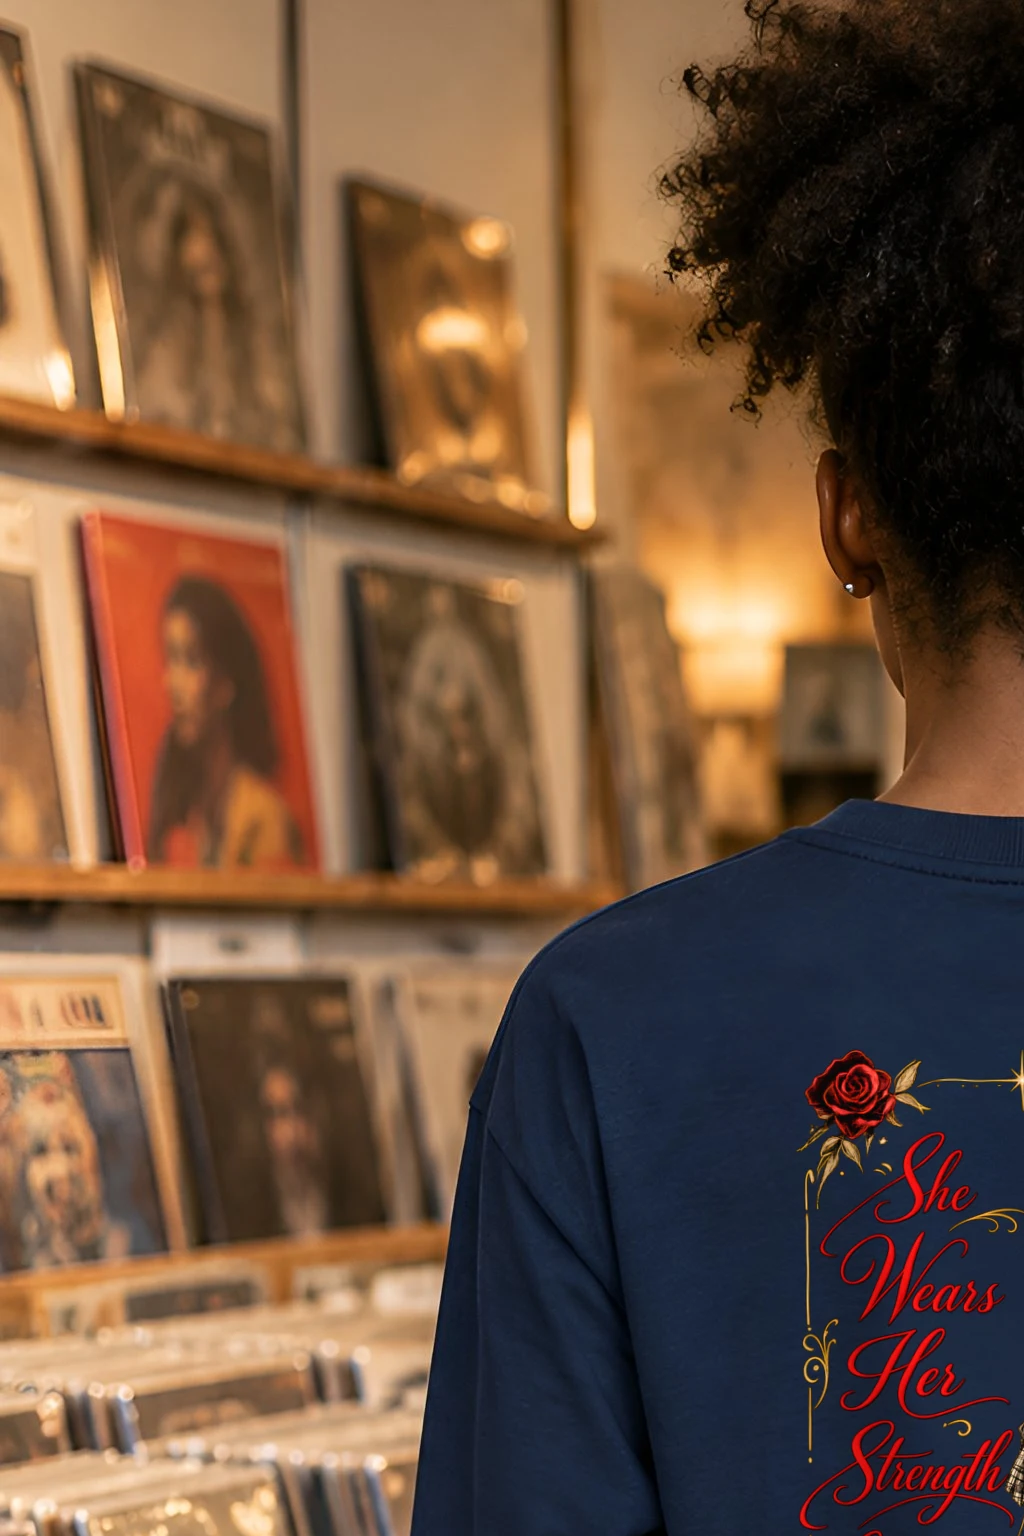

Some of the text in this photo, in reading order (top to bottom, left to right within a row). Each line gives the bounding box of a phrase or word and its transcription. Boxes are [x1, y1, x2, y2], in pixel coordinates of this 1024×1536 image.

[820, 1132, 977, 1257] She
[840, 1232, 1006, 1324] Wears
[839, 1328, 1010, 1419] Her
[799, 1420, 1015, 1530] Strength
